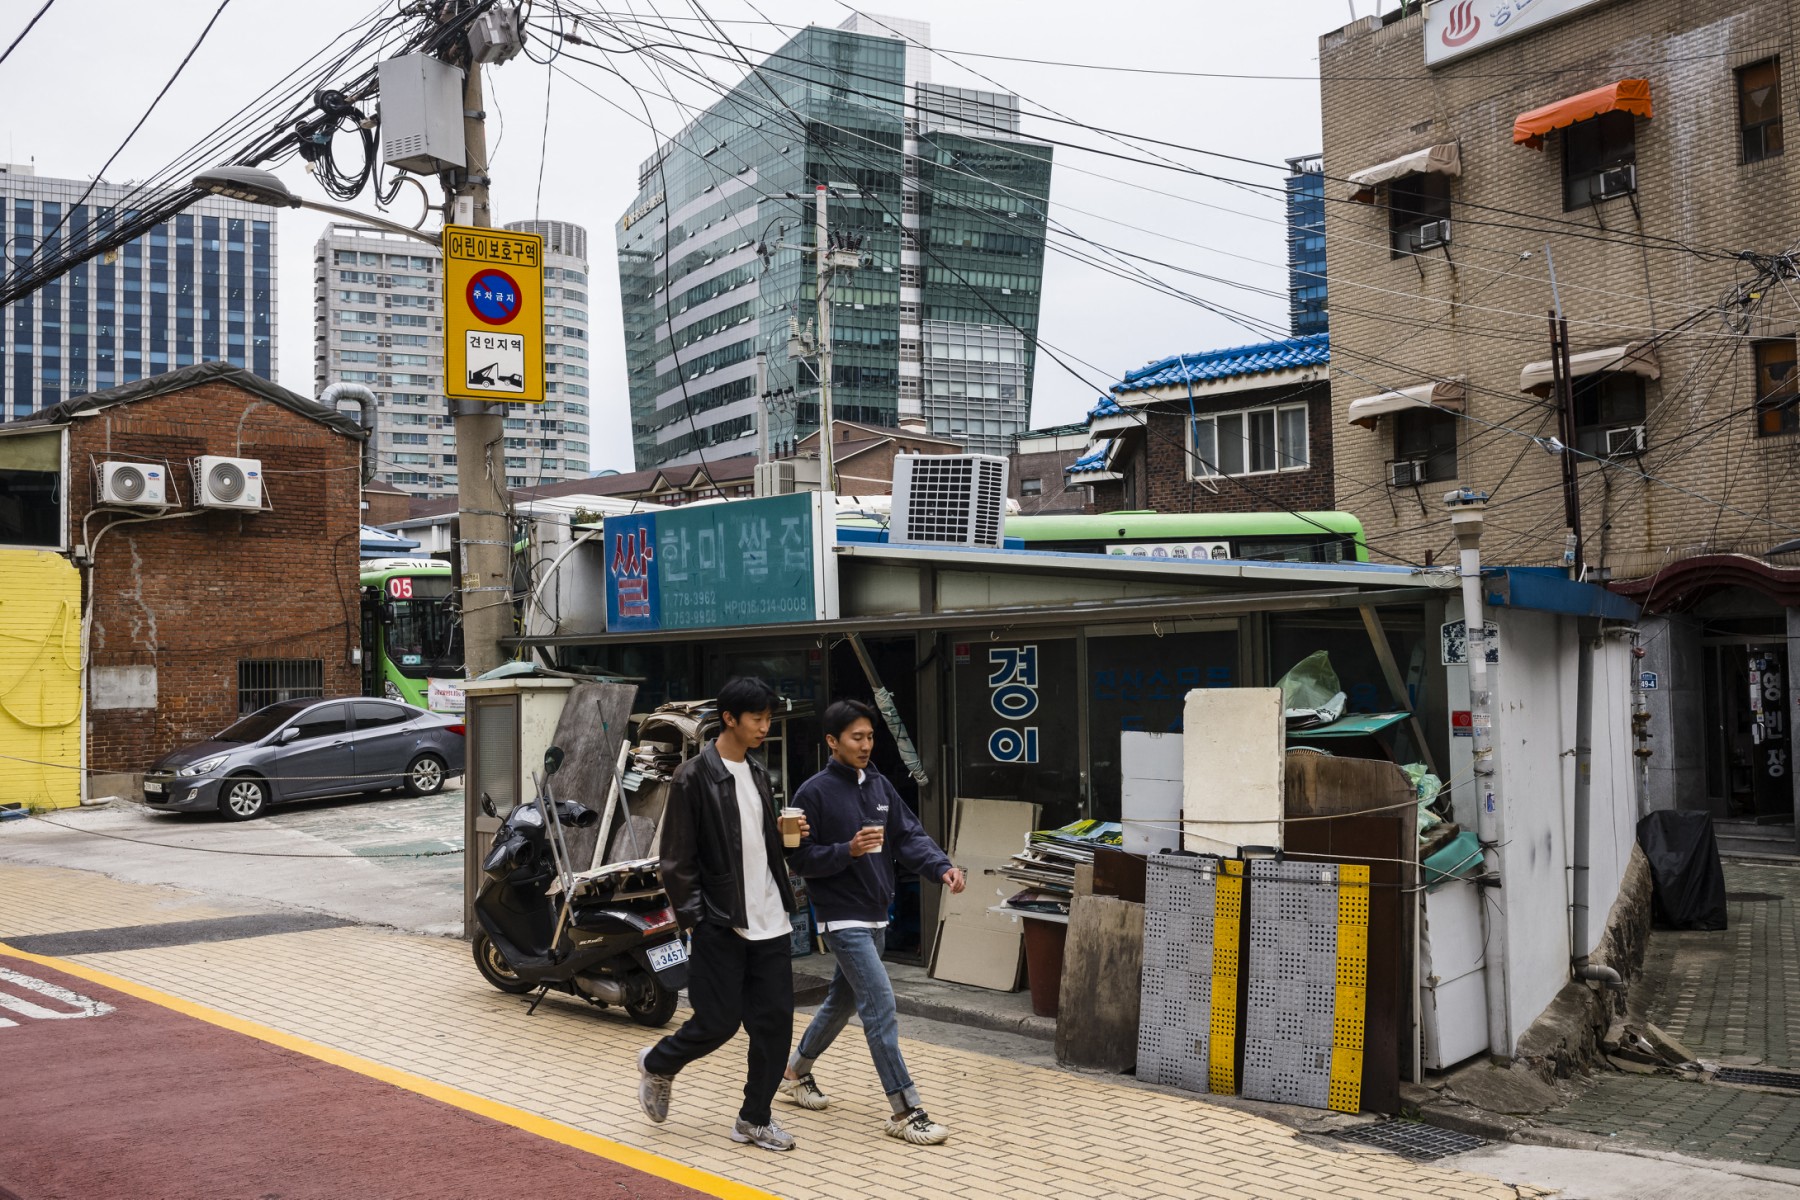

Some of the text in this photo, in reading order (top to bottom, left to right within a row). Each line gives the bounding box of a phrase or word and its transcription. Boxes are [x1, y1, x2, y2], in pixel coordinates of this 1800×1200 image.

[452, 235, 535, 265] 어린이보호구역
[473, 289, 514, 303] 주차금지
[470, 336, 521, 352] 견인지역
[611, 527, 653, 617] 쌀
[390, 578, 412, 597] 05
[660, 949, 684, 965] 3457
